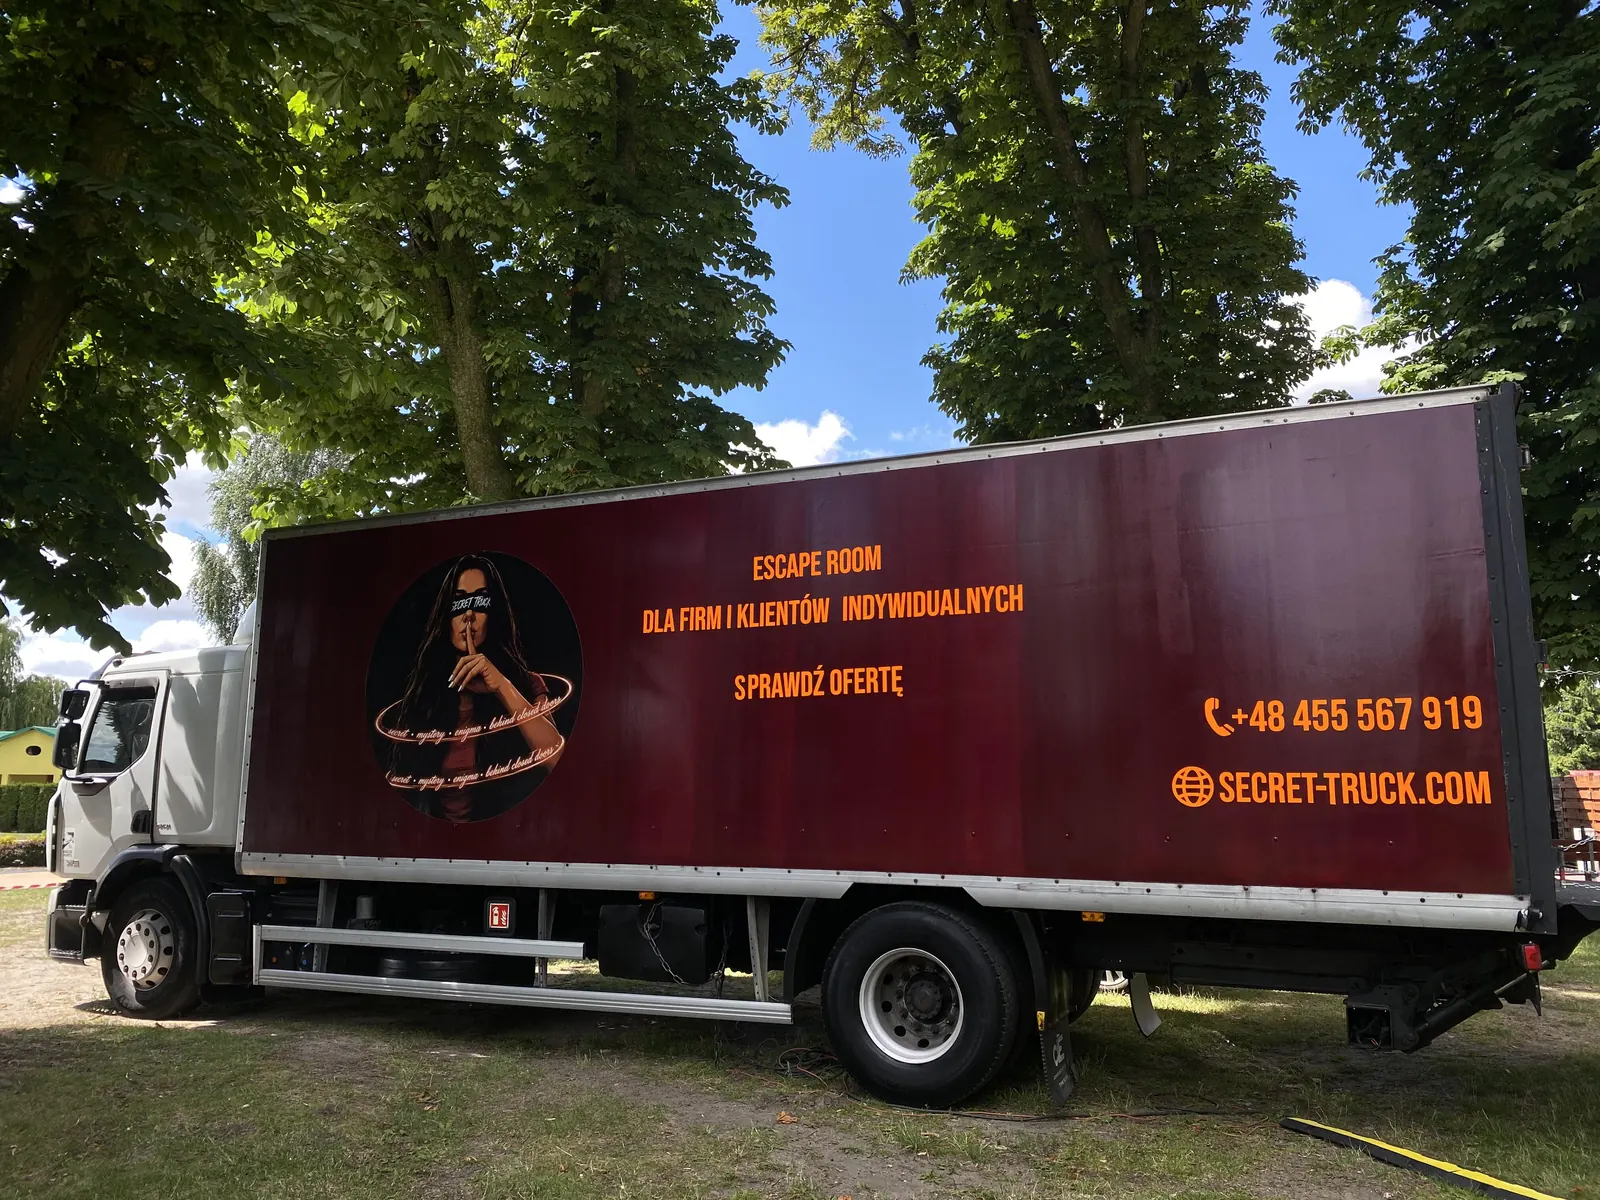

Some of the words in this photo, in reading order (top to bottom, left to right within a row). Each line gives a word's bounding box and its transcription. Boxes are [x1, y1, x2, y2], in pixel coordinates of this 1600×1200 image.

[753, 550, 822, 581] ESCAPE
[826, 544, 882, 576] ROOM
[451, 597, 474, 612] SECRET
[473, 595, 491, 608] TRUCK
[642, 608, 676, 634] DLA
[679, 605, 722, 632] FIRM
[726, 604, 733, 629] I
[736, 593, 830, 629] KLIENTÓW
[842, 583, 1024, 622] INDYWIDUALNYCH
[734, 664, 825, 701] SPRAWDŹ
[829, 665, 904, 698] OFERTĘ
[388, 728, 410, 738] secret
[415, 728, 446, 746] mystery
[454, 725, 482, 743] enigma
[488, 711, 517, 730] behind
[516, 701, 541, 721] closed
[540, 695, 562, 712] doors
[1231, 699, 1286, 732] +48
[1292, 698, 1349, 732] 455
[1356, 697, 1413, 732] 567
[1422, 695, 1483, 730] 919
[417, 775, 446, 791] mystery
[452, 773, 480, 790] enigma
[485, 758, 512, 778] behind
[511, 749, 538, 770] closed
[1218, 770, 1492, 806] SECRET-TRUCK.COM
